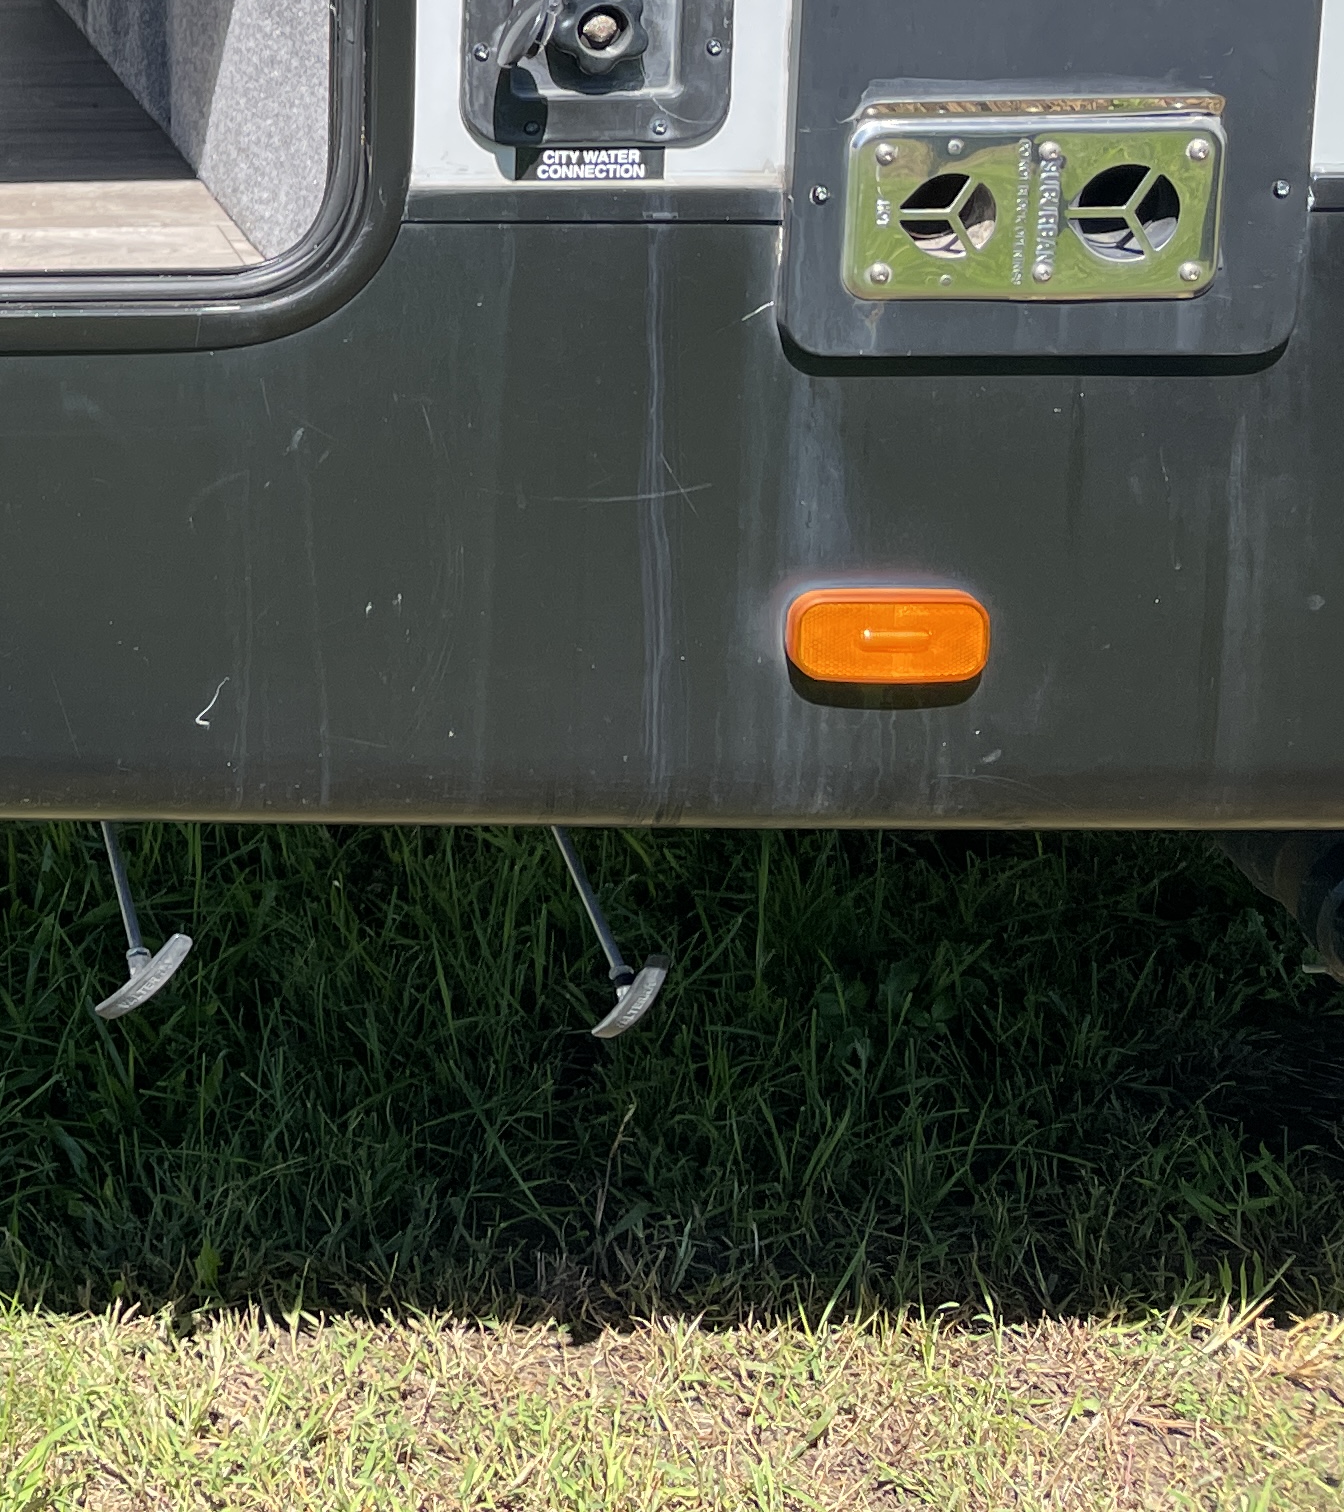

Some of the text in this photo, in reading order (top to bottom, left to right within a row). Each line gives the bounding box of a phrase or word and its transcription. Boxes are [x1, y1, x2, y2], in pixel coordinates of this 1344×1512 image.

[542, 149, 640, 164] CITY WATER
[537, 164, 645, 178] CONNECTION
[1035, 159, 1061, 265] SUBURBAN
